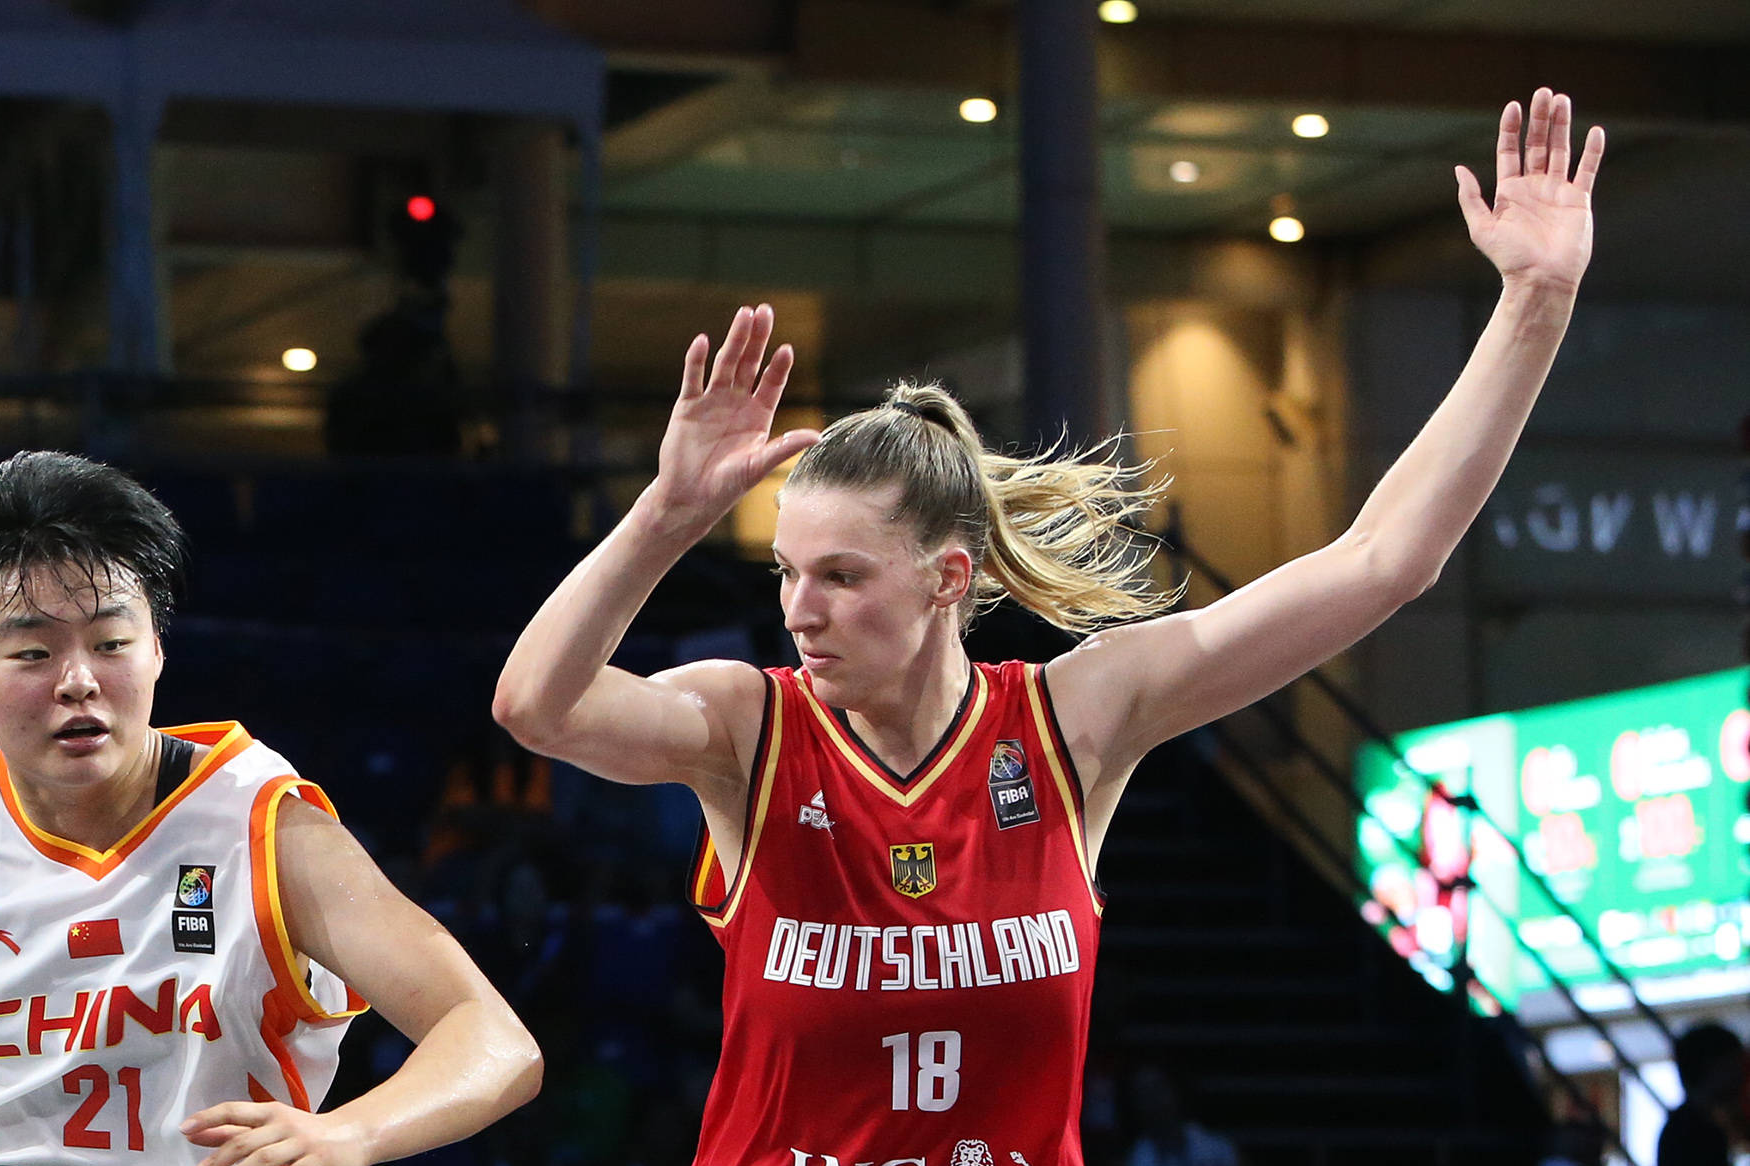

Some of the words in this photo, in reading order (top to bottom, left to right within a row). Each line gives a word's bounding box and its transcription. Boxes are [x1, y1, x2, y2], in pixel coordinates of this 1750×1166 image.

[798, 804, 835, 829] PEA
[997, 785, 1029, 805] FIBA
[178, 916, 208, 932] FIBA
[763, 909, 1080, 991] DEUTSCHLAND
[882, 1030, 962, 1112] 18
[62, 1064, 144, 1152] 21
